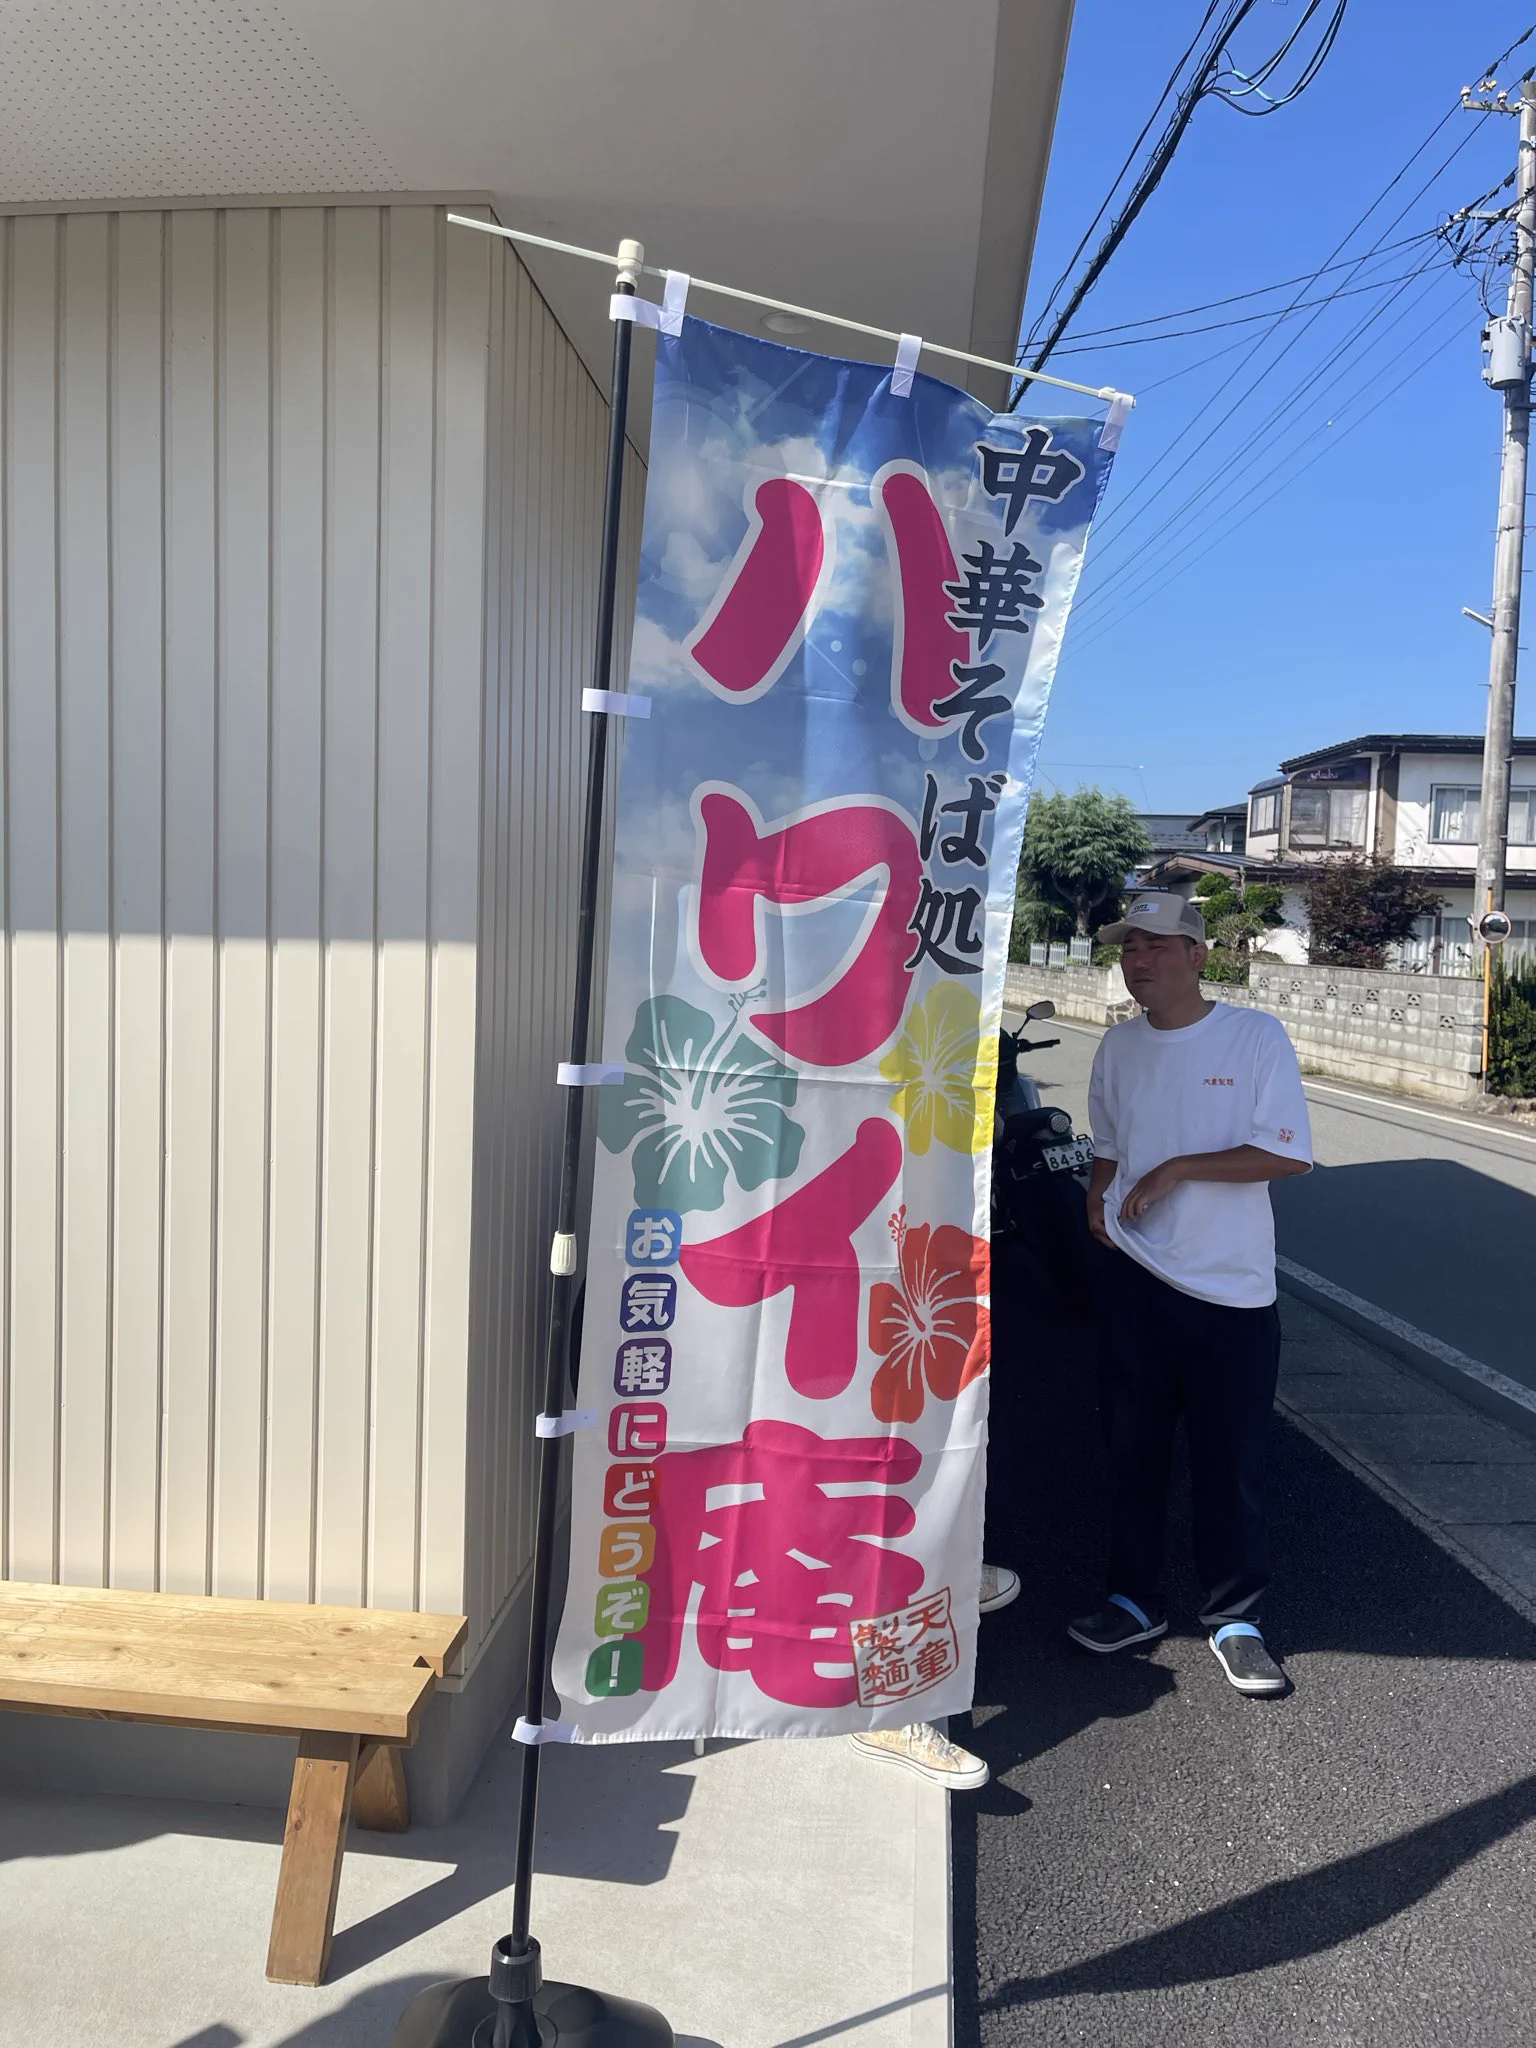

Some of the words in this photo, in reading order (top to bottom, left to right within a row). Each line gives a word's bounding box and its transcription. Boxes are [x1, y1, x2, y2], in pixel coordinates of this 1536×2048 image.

[904, 428, 1082, 975] 中華そば処
[630, 470, 971, 1708] ハワイ庵
[1049, 1147, 1094, 1169] 84-86
[906, 1598, 952, 1688] 天童
